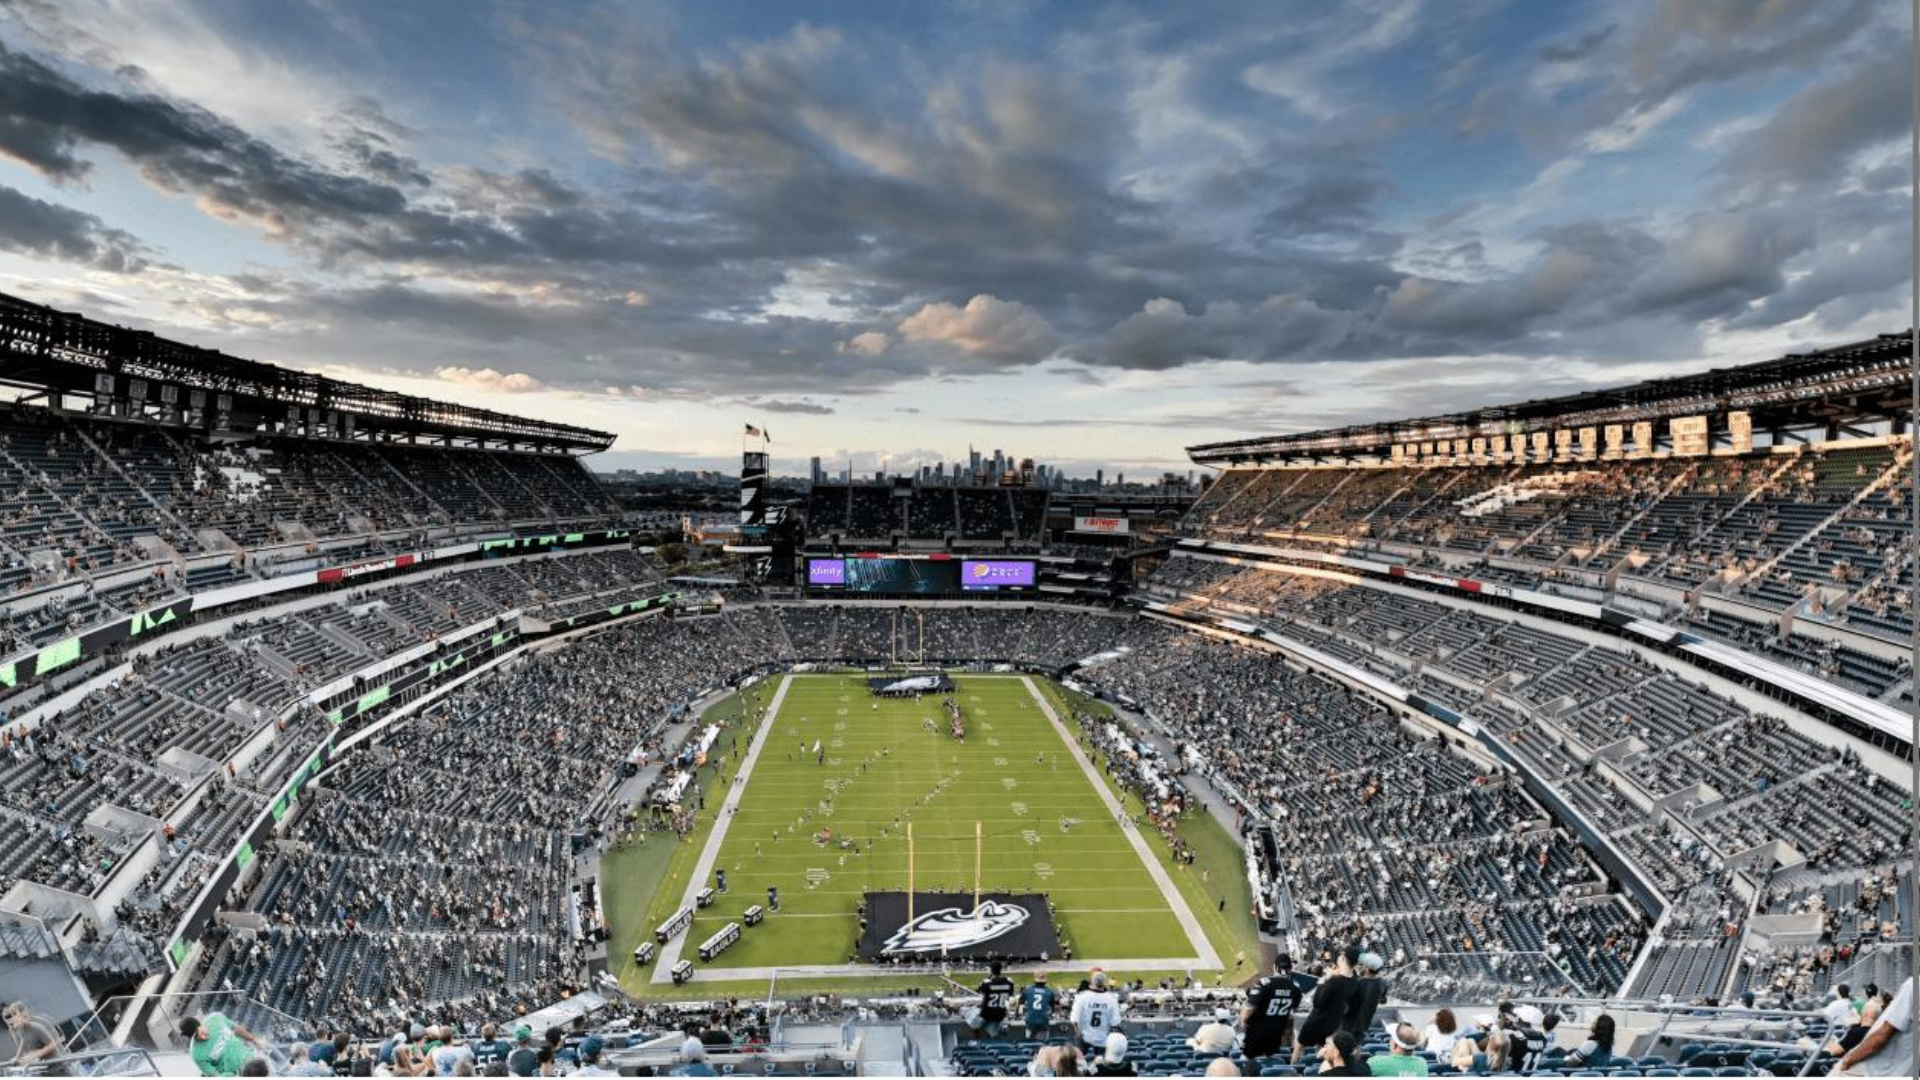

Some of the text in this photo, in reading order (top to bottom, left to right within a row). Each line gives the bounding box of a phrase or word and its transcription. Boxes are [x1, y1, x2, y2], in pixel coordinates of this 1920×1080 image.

[811, 565, 842, 578] xfinity
[666, 911, 692, 940] EAGLES
[710, 930, 739, 958] EAGLES
[1032, 994, 1043, 1010] 2
[1266, 998, 1293, 1016] 62
[1090, 1010, 1102, 1027] 6
[1521, 1052, 1541, 1071] 11
